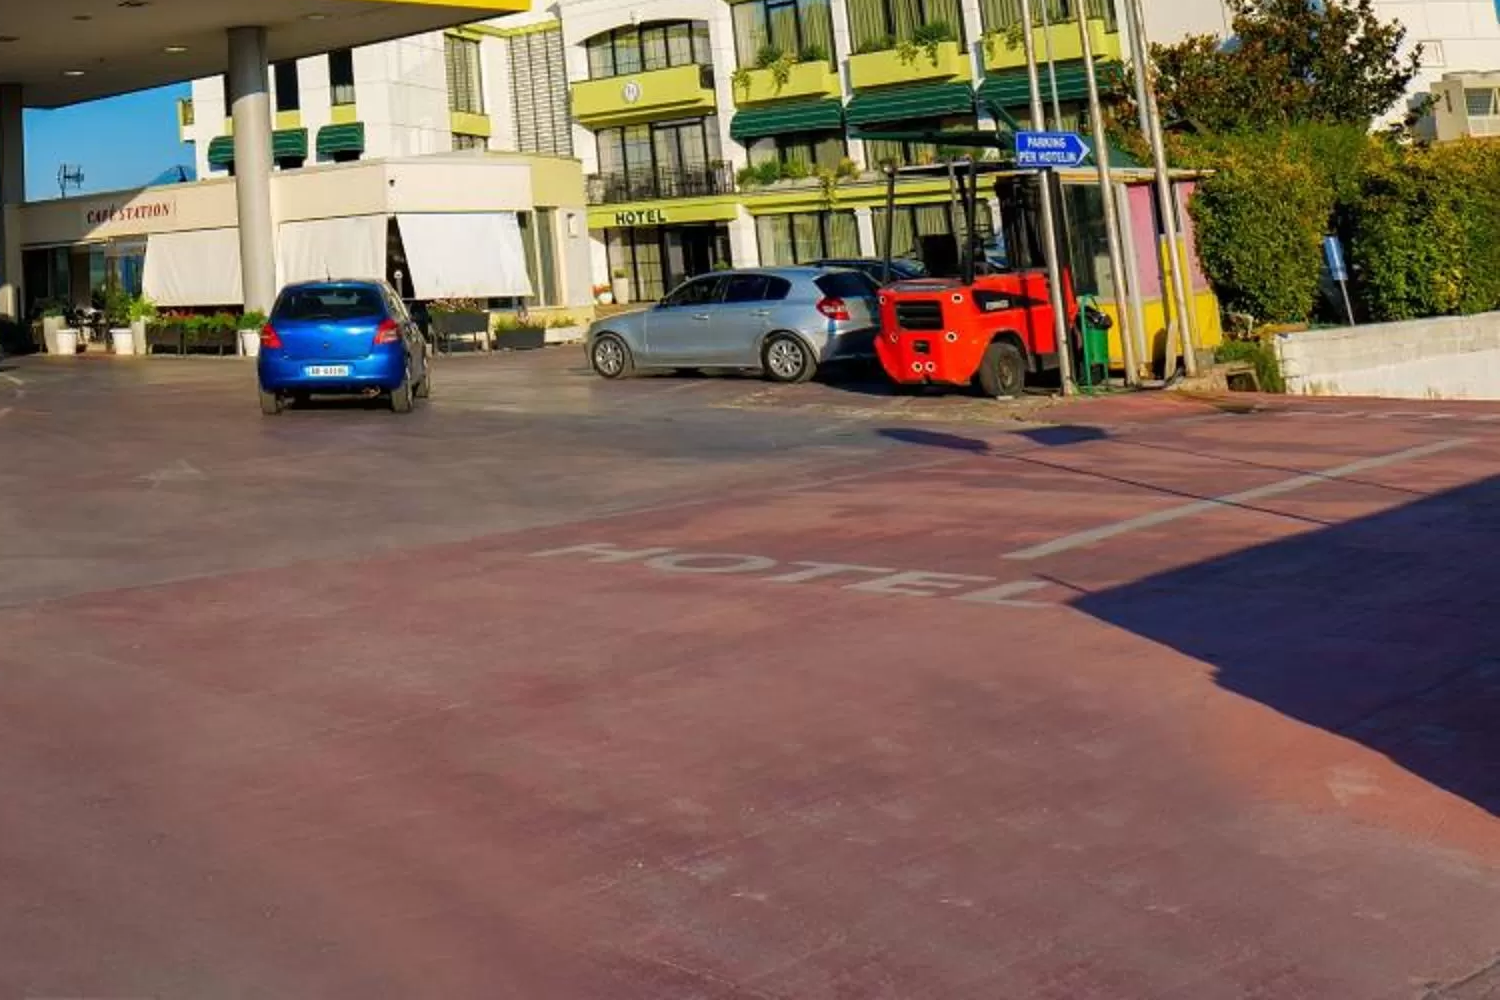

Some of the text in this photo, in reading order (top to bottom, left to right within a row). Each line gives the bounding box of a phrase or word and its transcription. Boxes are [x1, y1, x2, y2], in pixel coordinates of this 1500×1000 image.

[1027, 136, 1067, 149] PARKING
[118, 203, 170, 221] STATION
[615, 209, 668, 226] HOTEL
[527, 543, 1064, 609] HOTEL
